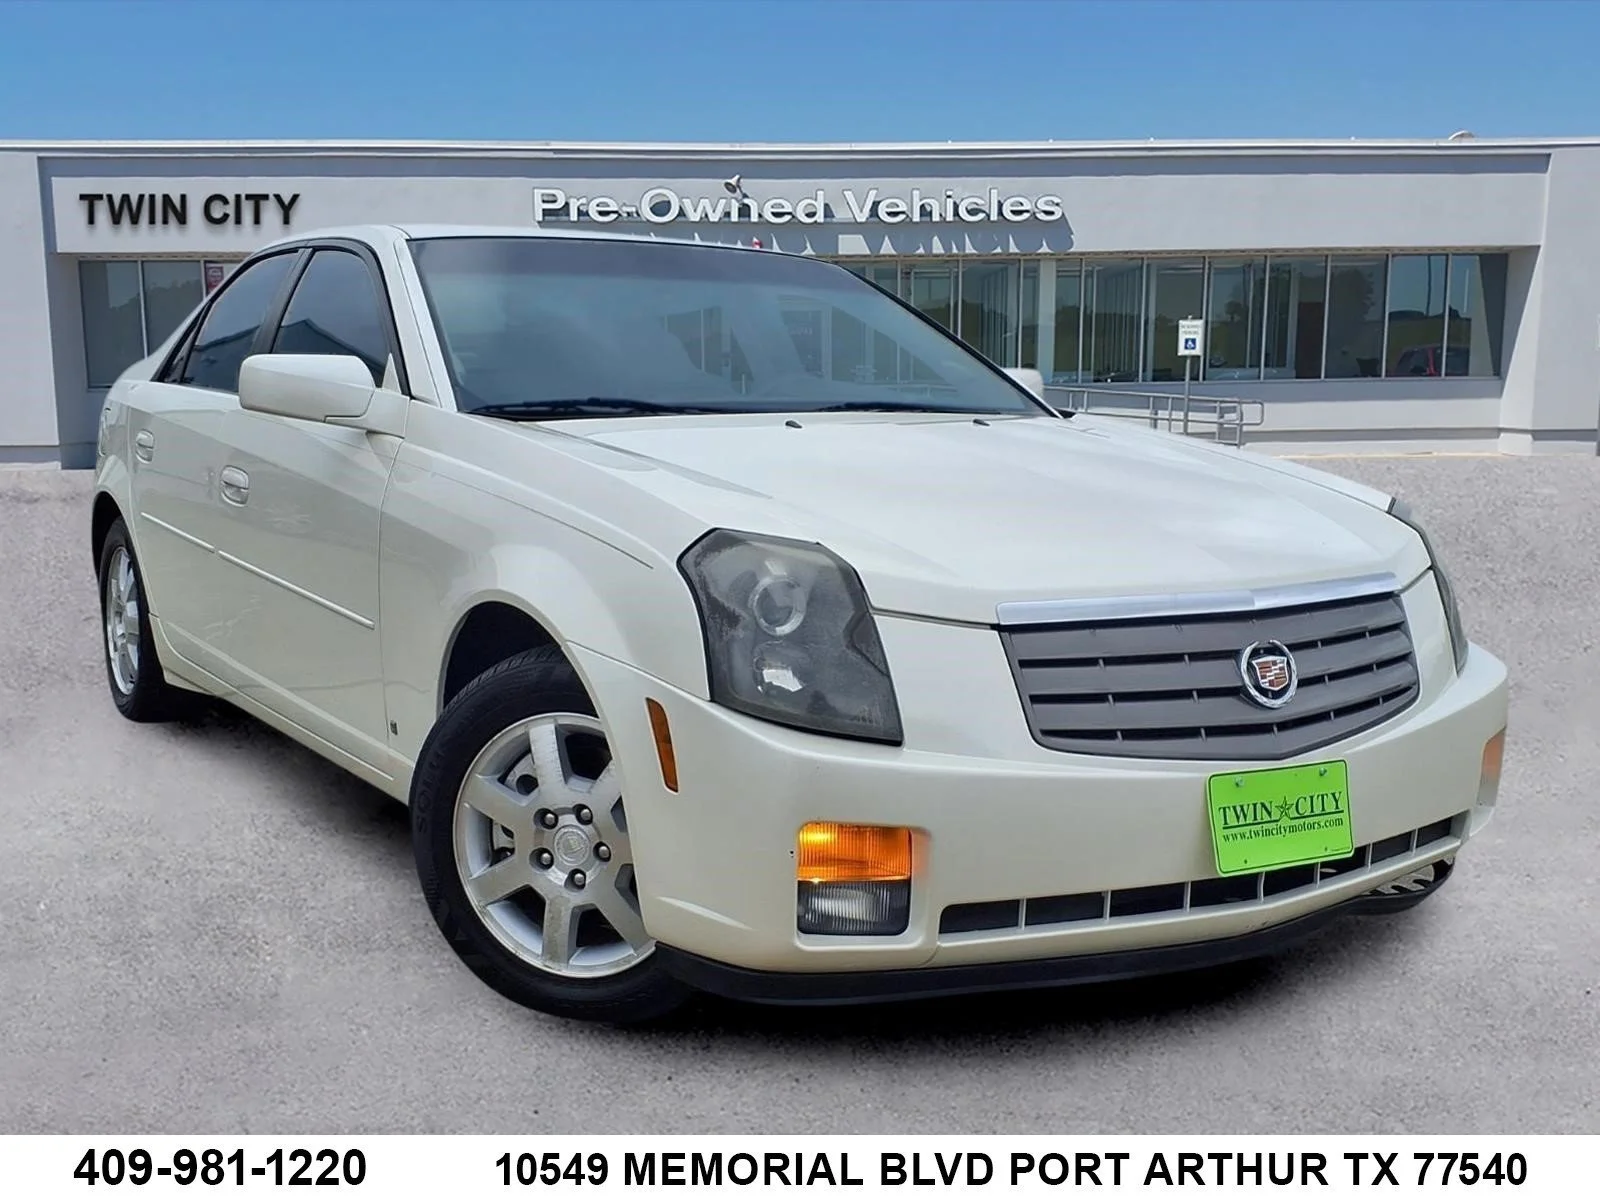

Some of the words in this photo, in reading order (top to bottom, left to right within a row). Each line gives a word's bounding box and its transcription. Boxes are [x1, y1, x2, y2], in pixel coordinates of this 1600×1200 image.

[79, 193, 188, 226] TWIN
[203, 193, 300, 225] CITY
[532, 186, 826, 224] Pre-Owned
[842, 187, 1064, 224] Vehicles
[1218, 800, 1273, 826] TWIN
[1295, 791, 1342, 816] CITY
[1222, 817, 1344, 843] www.twincitymotors.com
